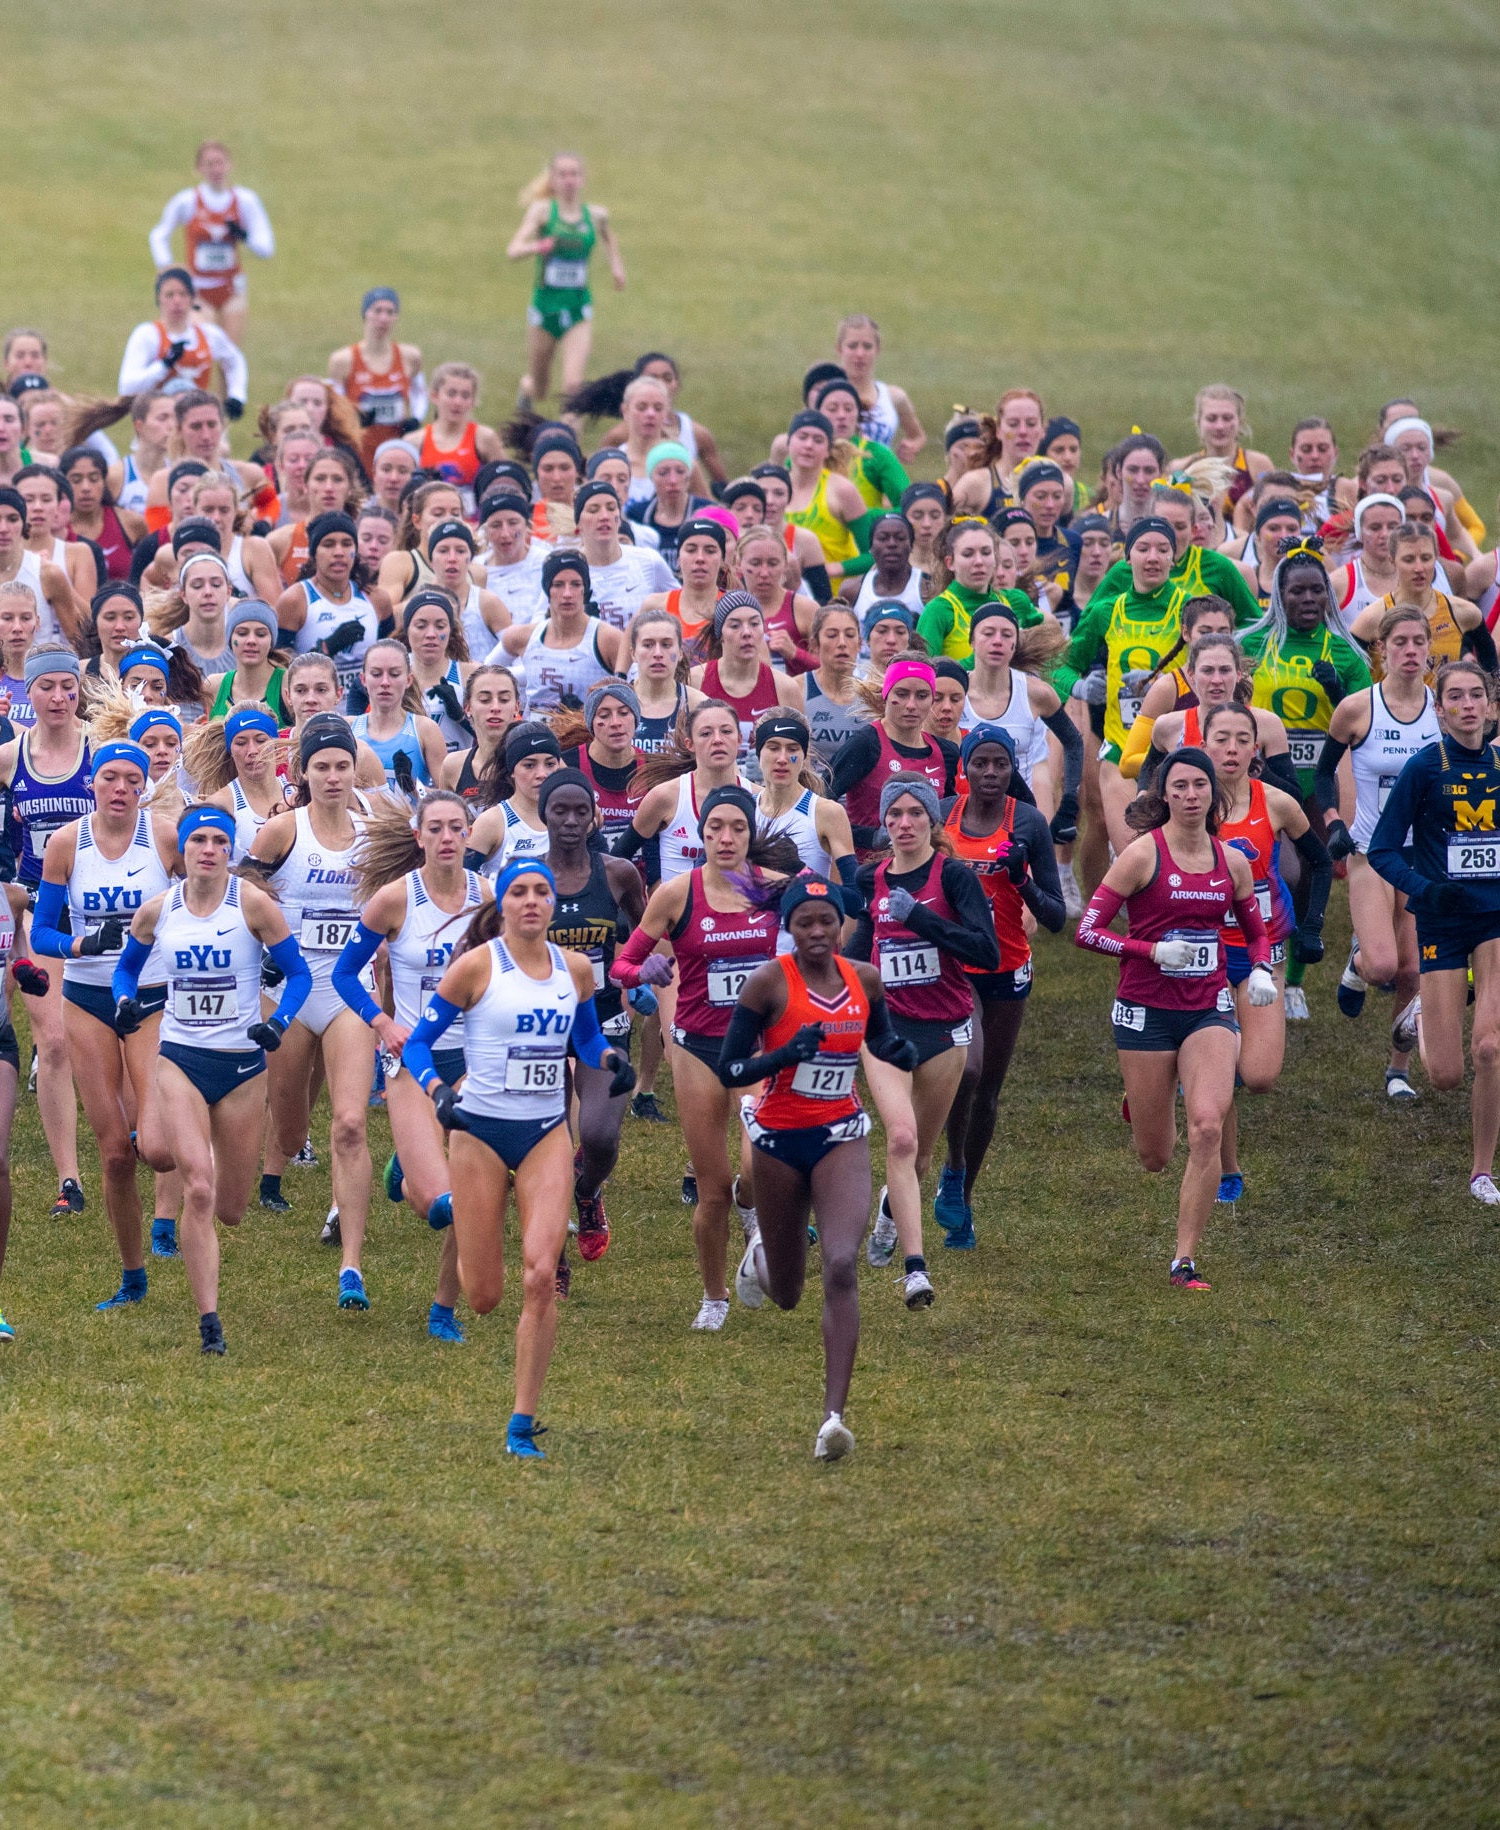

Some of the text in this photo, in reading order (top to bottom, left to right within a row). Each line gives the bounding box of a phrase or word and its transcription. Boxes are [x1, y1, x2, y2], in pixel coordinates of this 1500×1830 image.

[811, 728, 853, 742] XAVI
[1383, 747, 1405, 755] PENN
[17, 797, 96, 817] WASHINGTON
[601, 807, 638, 818] KANSA
[1453, 799, 1496, 831] M
[962, 862, 1003, 874] EP
[1461, 847, 1496, 868] 253
[306, 869, 358, 884] FLORI
[83, 886, 142, 912] BYU
[1170, 890, 1226, 902] ARKANSAS
[315, 923, 352, 945] 187
[704, 929, 767, 943] ARKANSAS
[1096, 935, 1124, 954] SOOIE
[175, 945, 231, 971] BYU
[426, 943, 453, 967] BY
[1189, 946, 1209, 967] 19
[1423, 945, 1437, 960] M
[889, 952, 927, 976] 114
[722, 973, 747, 996] 12
[187, 994, 224, 1016] 147
[516, 1008, 571, 1036] BYU
[801, 1021, 863, 1035] BURN
[522, 1063, 558, 1086] 153
[811, 1070, 845, 1091] 121
